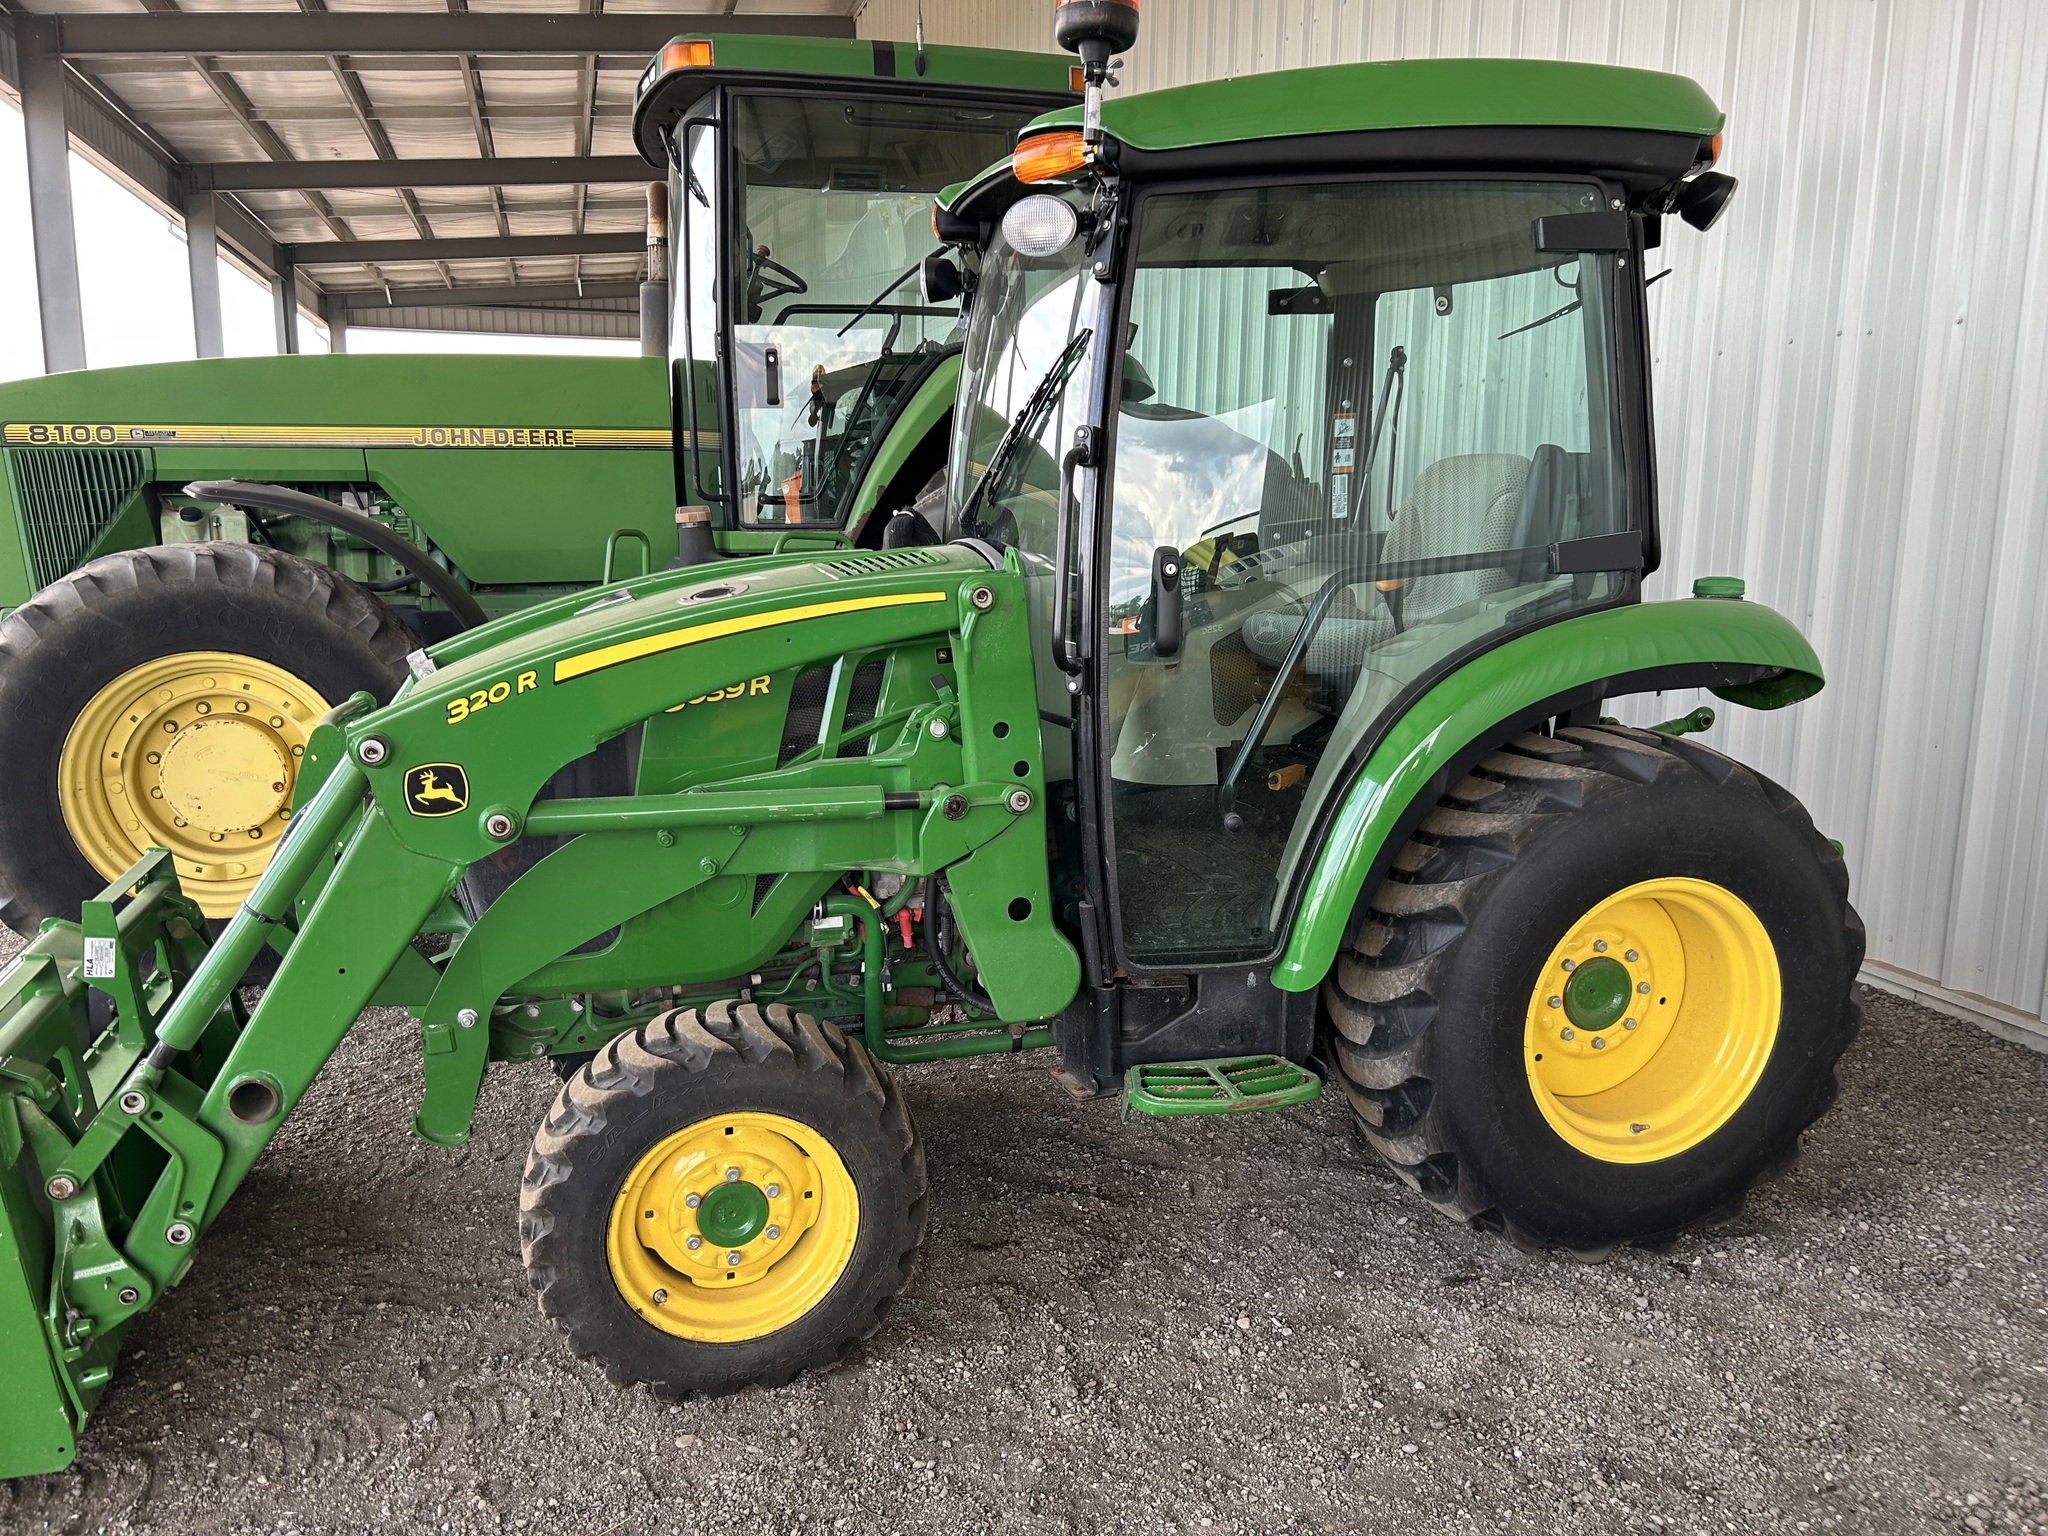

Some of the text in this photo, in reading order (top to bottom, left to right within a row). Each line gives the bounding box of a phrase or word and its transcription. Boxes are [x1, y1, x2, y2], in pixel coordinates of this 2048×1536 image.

[28, 425, 117, 444] 8100
[413, 428, 575, 447] JOHN DEERE
[446, 670, 539, 725] 320 R
[86, 958, 94, 977] HLA
[586, 1070, 735, 1166] GALAXY
